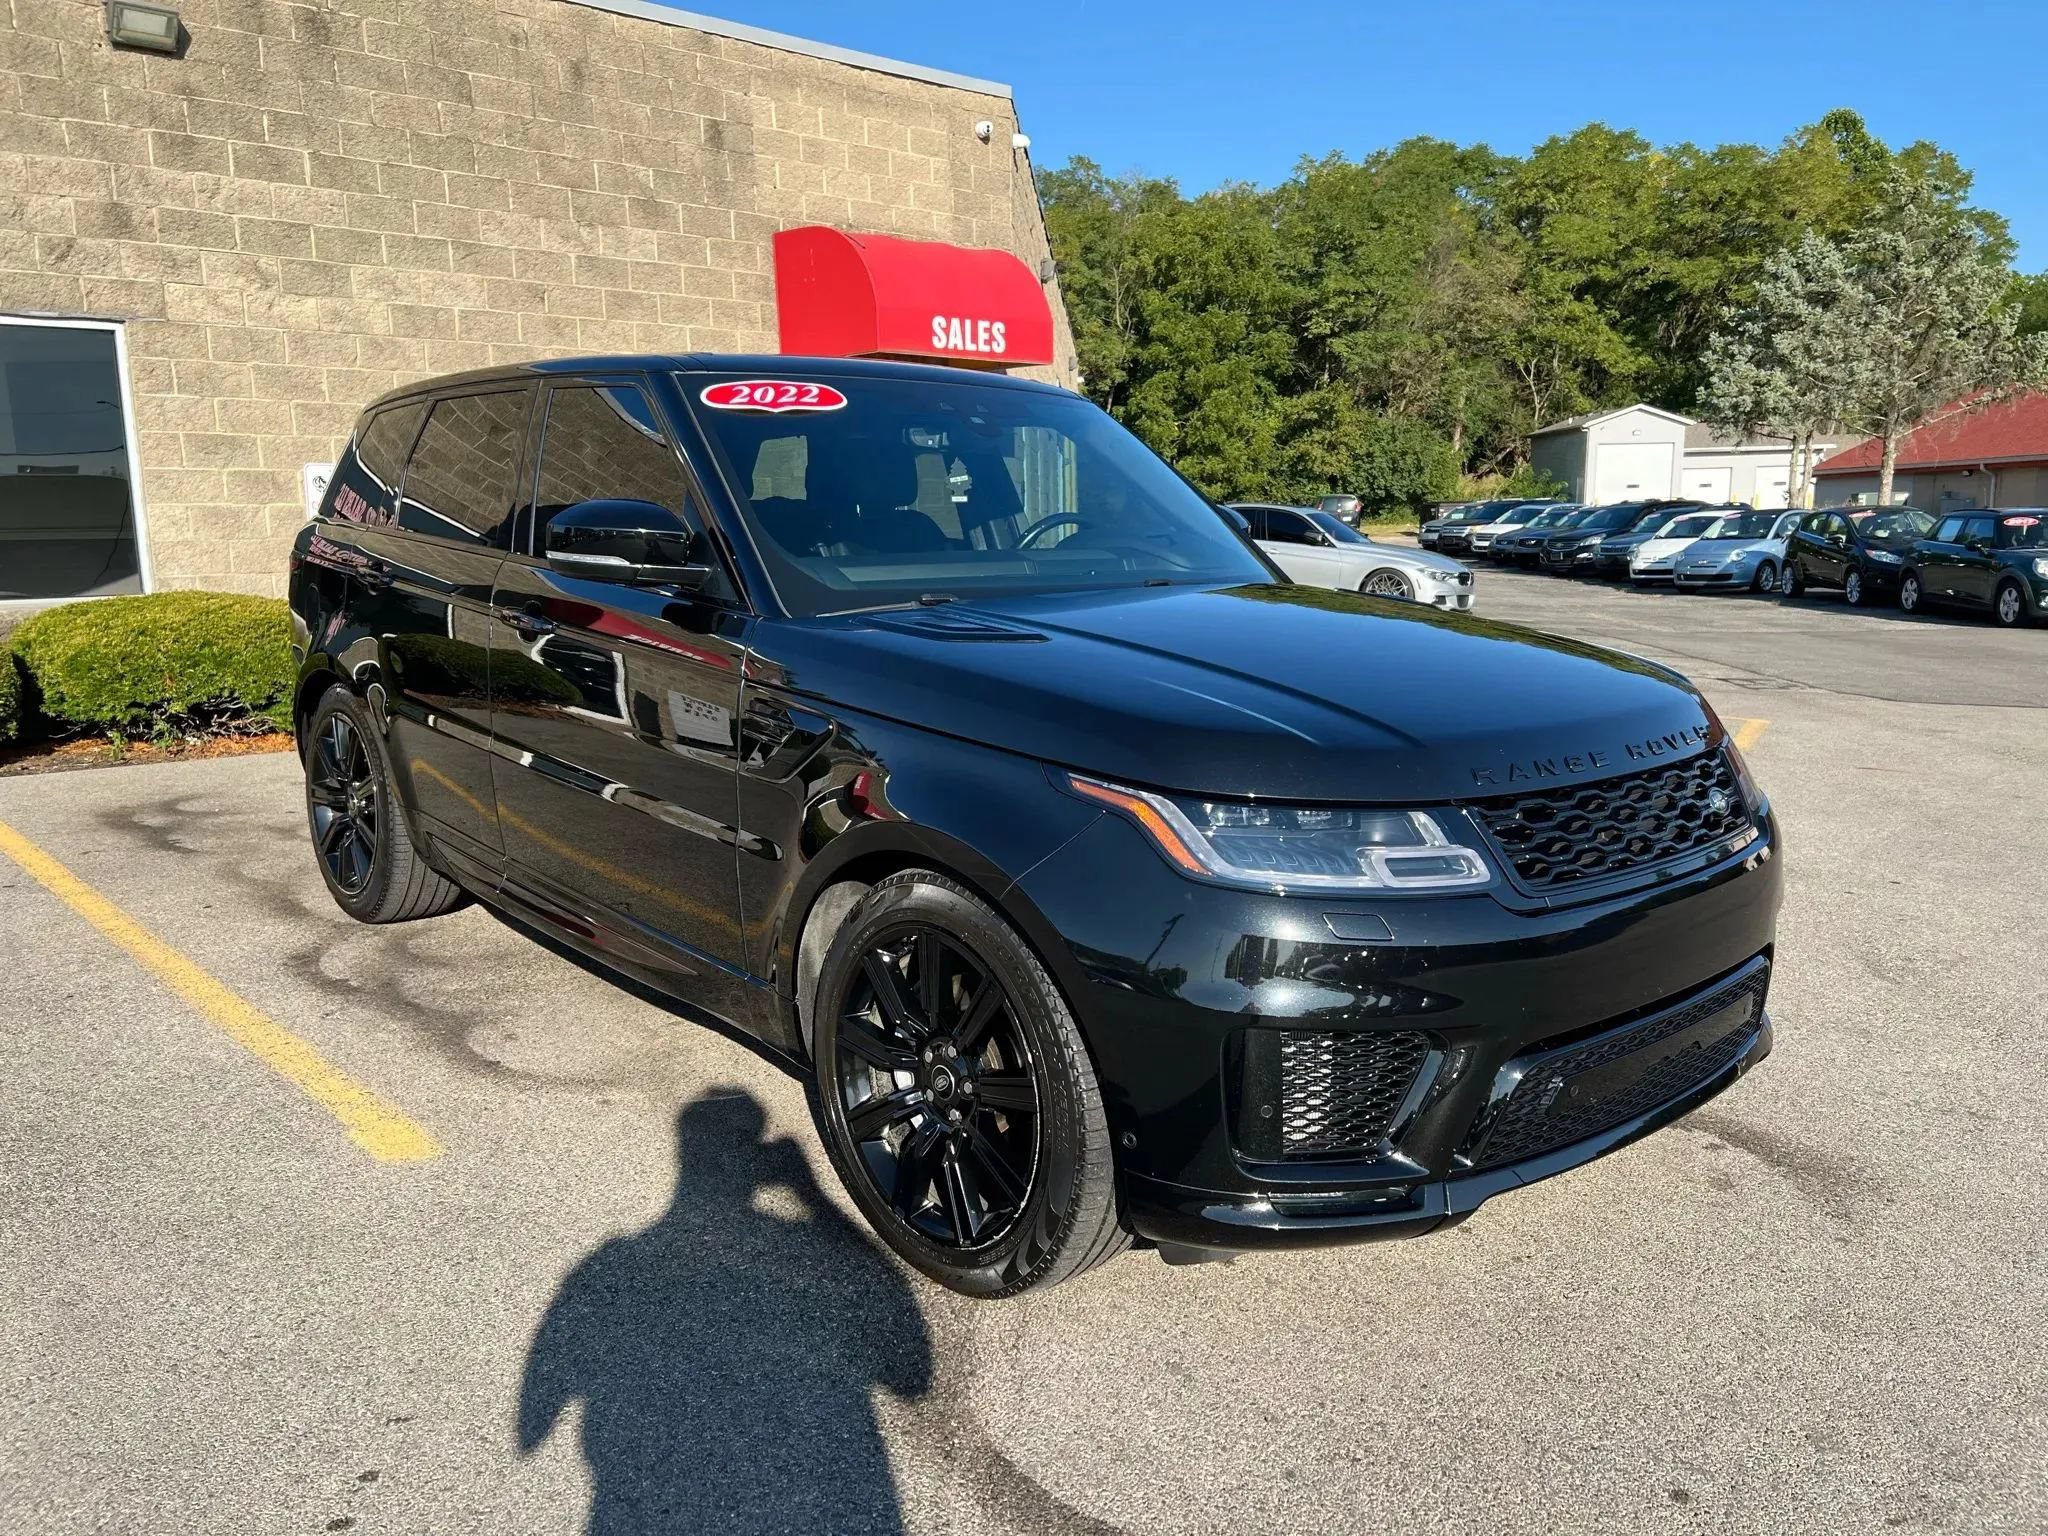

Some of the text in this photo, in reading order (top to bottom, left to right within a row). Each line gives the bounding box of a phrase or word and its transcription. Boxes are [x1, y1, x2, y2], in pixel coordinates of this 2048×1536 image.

[931, 314, 1006, 354] SALES
[729, 385, 820, 404] 2022
[1470, 724, 1711, 785] RANGE ROVER
